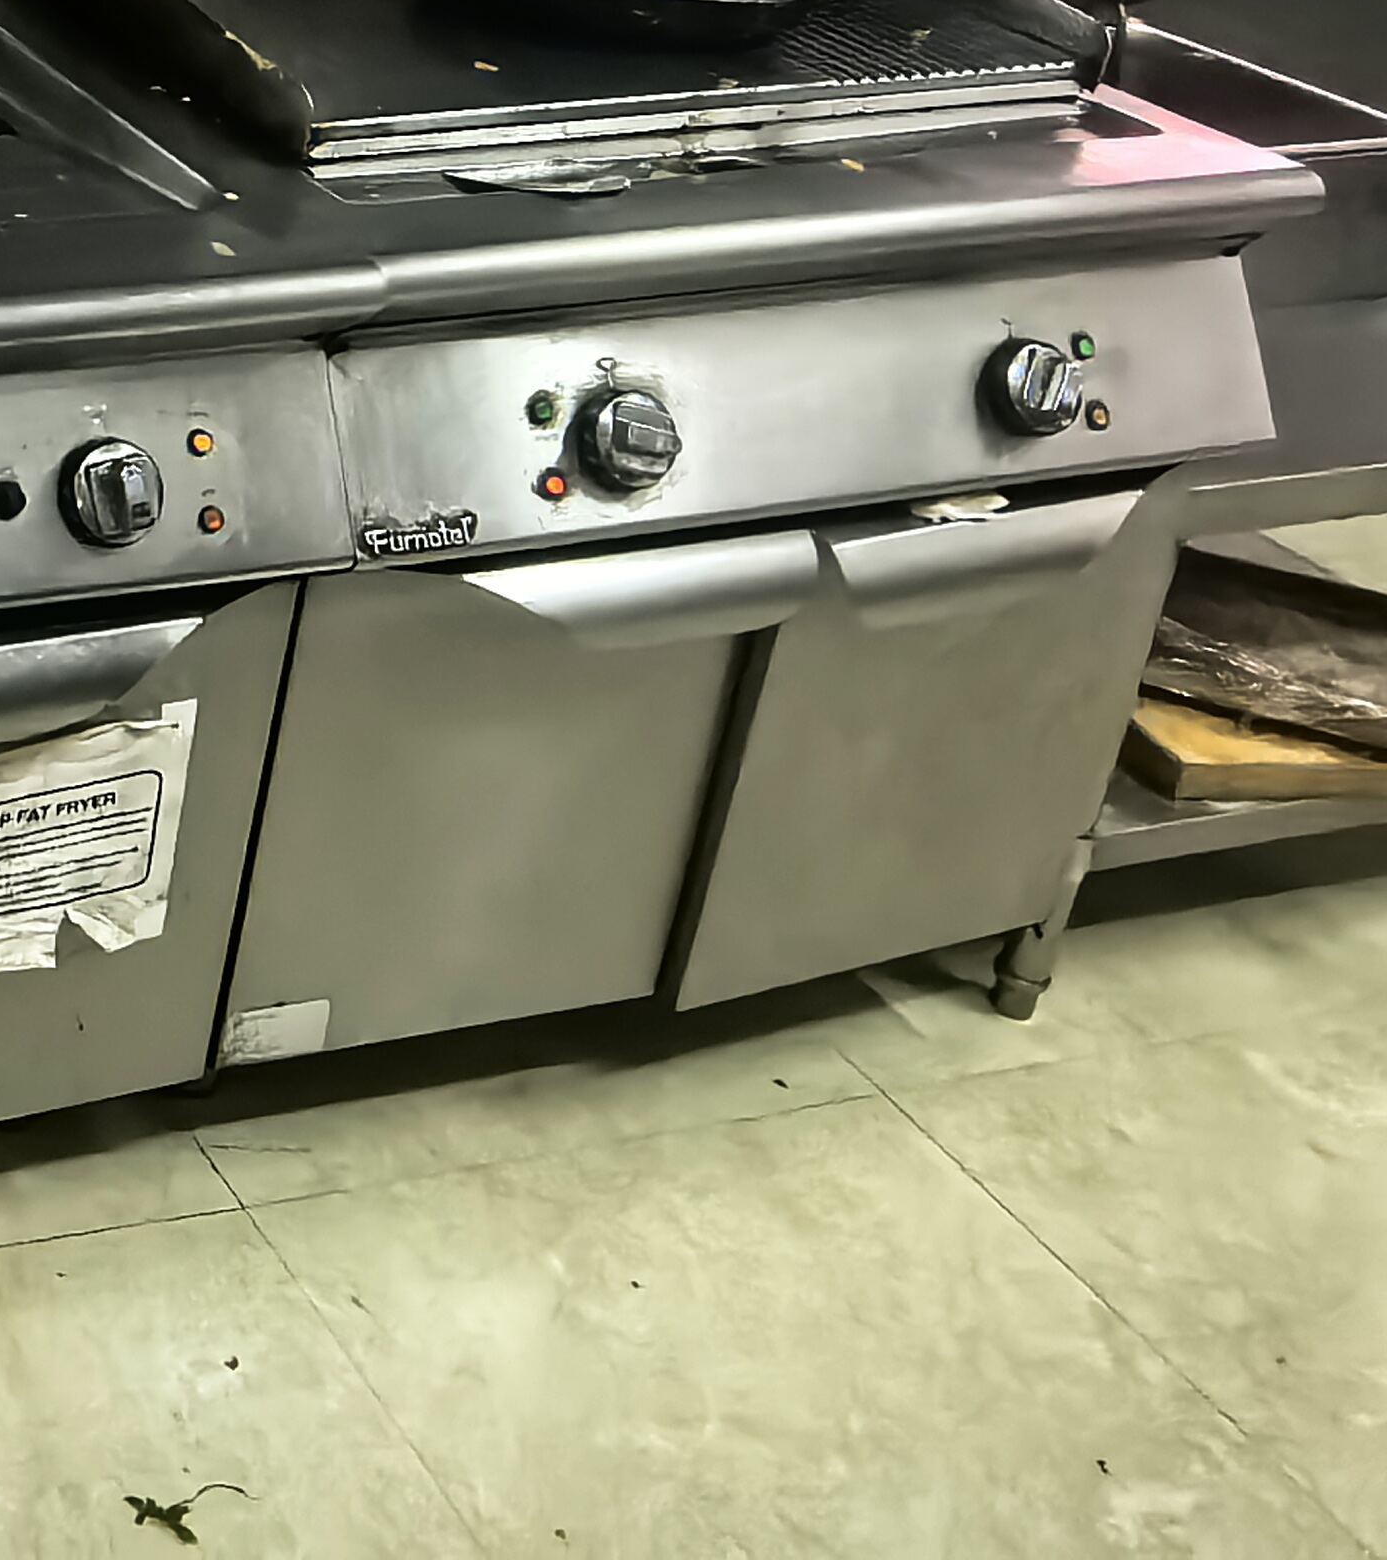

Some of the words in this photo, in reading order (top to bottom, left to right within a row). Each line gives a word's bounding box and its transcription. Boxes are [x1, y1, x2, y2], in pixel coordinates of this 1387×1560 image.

[364, 517, 472, 554] Furnotel
[16, 803, 52, 825] FAT
[56, 791, 117, 817] FRYER
